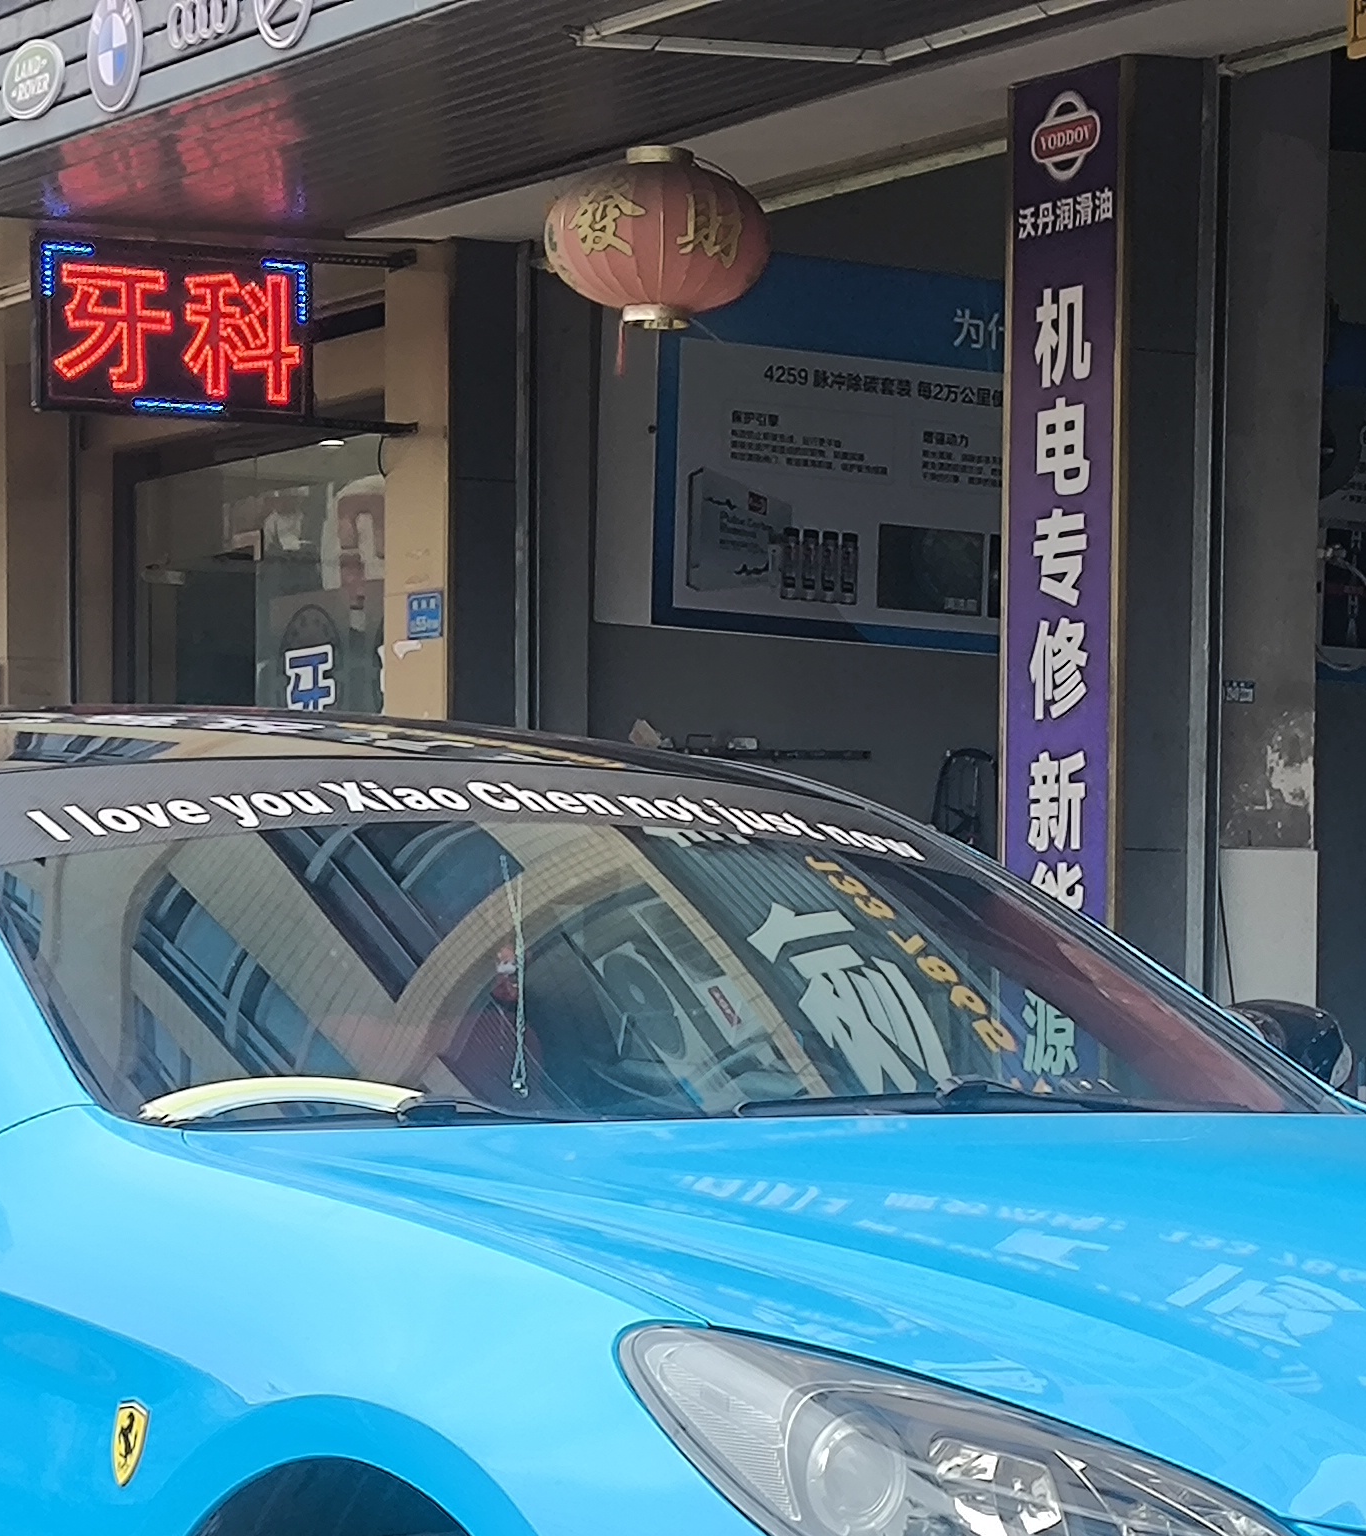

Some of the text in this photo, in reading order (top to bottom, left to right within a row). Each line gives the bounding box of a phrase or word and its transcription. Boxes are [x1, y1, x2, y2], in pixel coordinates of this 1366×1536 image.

[14, 54, 43, 81] LAND
[15, 73, 49, 103] ROVER
[1017, 186, 1114, 240] 沃丹润滑油
[53, 261, 302, 406] 牙科
[763, 363, 809, 388] 4259
[1027, 283, 1093, 722] 机电专修
[24, 808, 72, 842] I
[67, 795, 212, 838] love
[209, 782, 322, 830] you
[320, 780, 473, 814] Xiao
[464, 780, 623, 822] Chen
[617, 793, 711, 826] not
[705, 797, 822, 842] just
[815, 822, 928, 862] now
